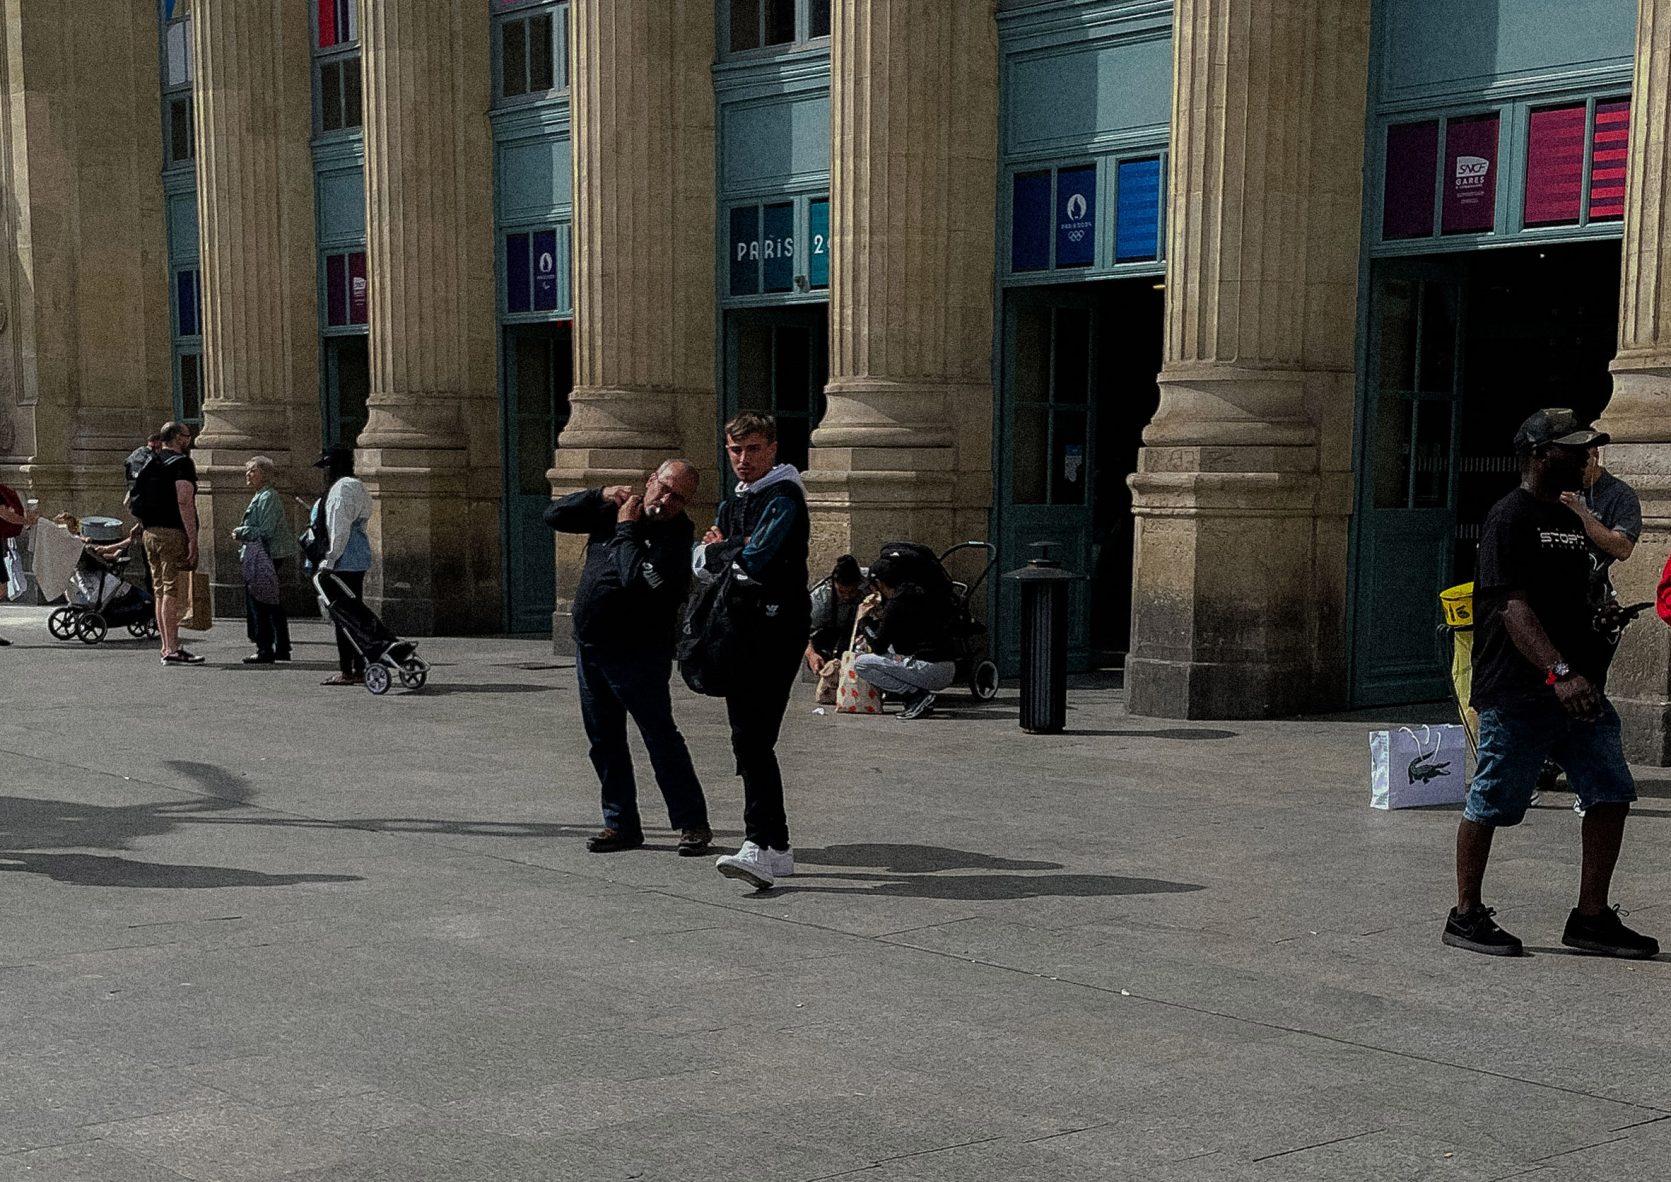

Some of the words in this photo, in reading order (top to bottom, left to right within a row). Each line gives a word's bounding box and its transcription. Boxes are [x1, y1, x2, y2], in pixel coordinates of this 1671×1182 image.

[1458, 162, 1487, 175] SNCF
[1455, 176, 1485, 186] GARES
[814, 234, 831, 255] 2
